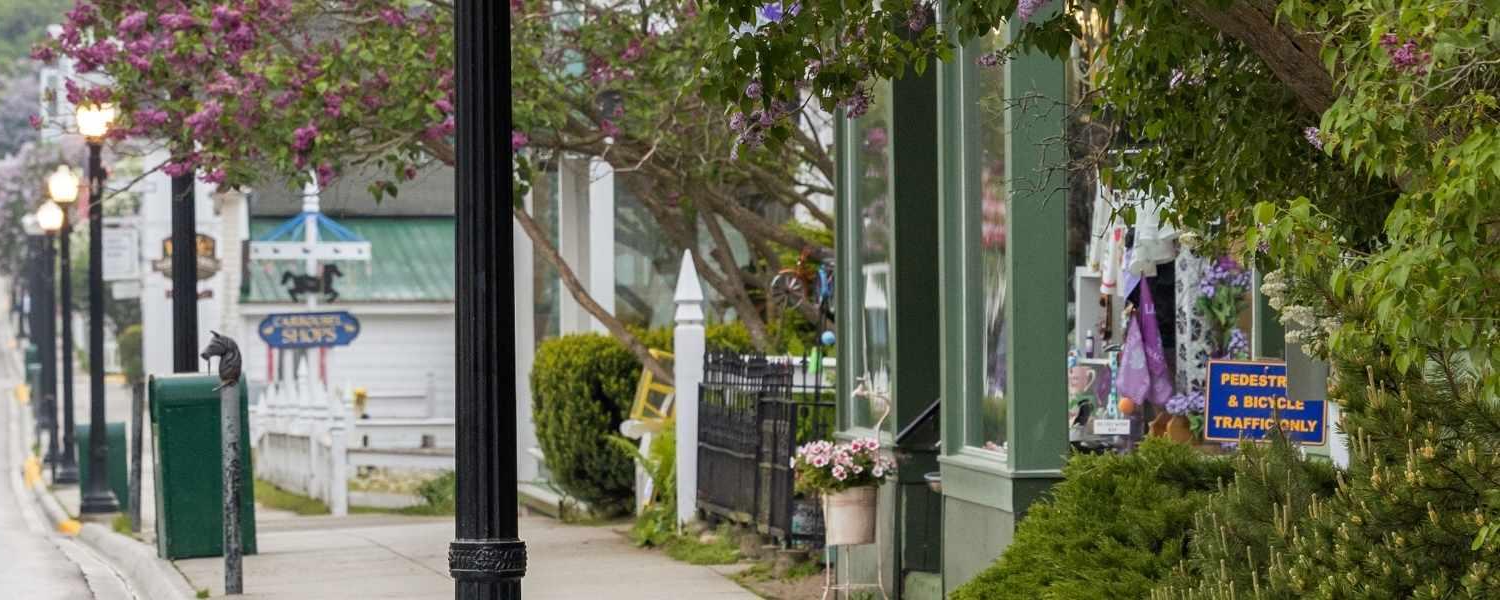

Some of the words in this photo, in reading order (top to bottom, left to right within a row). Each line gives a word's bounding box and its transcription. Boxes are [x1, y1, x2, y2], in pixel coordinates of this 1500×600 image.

[281, 327, 337, 344] SHOPS
[1221, 373, 1287, 387] PEDESTR
[1228, 395, 1238, 408] &
[1243, 395, 1305, 410] BICYCLE
[1213, 416, 1275, 430] TRAFFIC
[1279, 419, 1317, 432] ONLY
